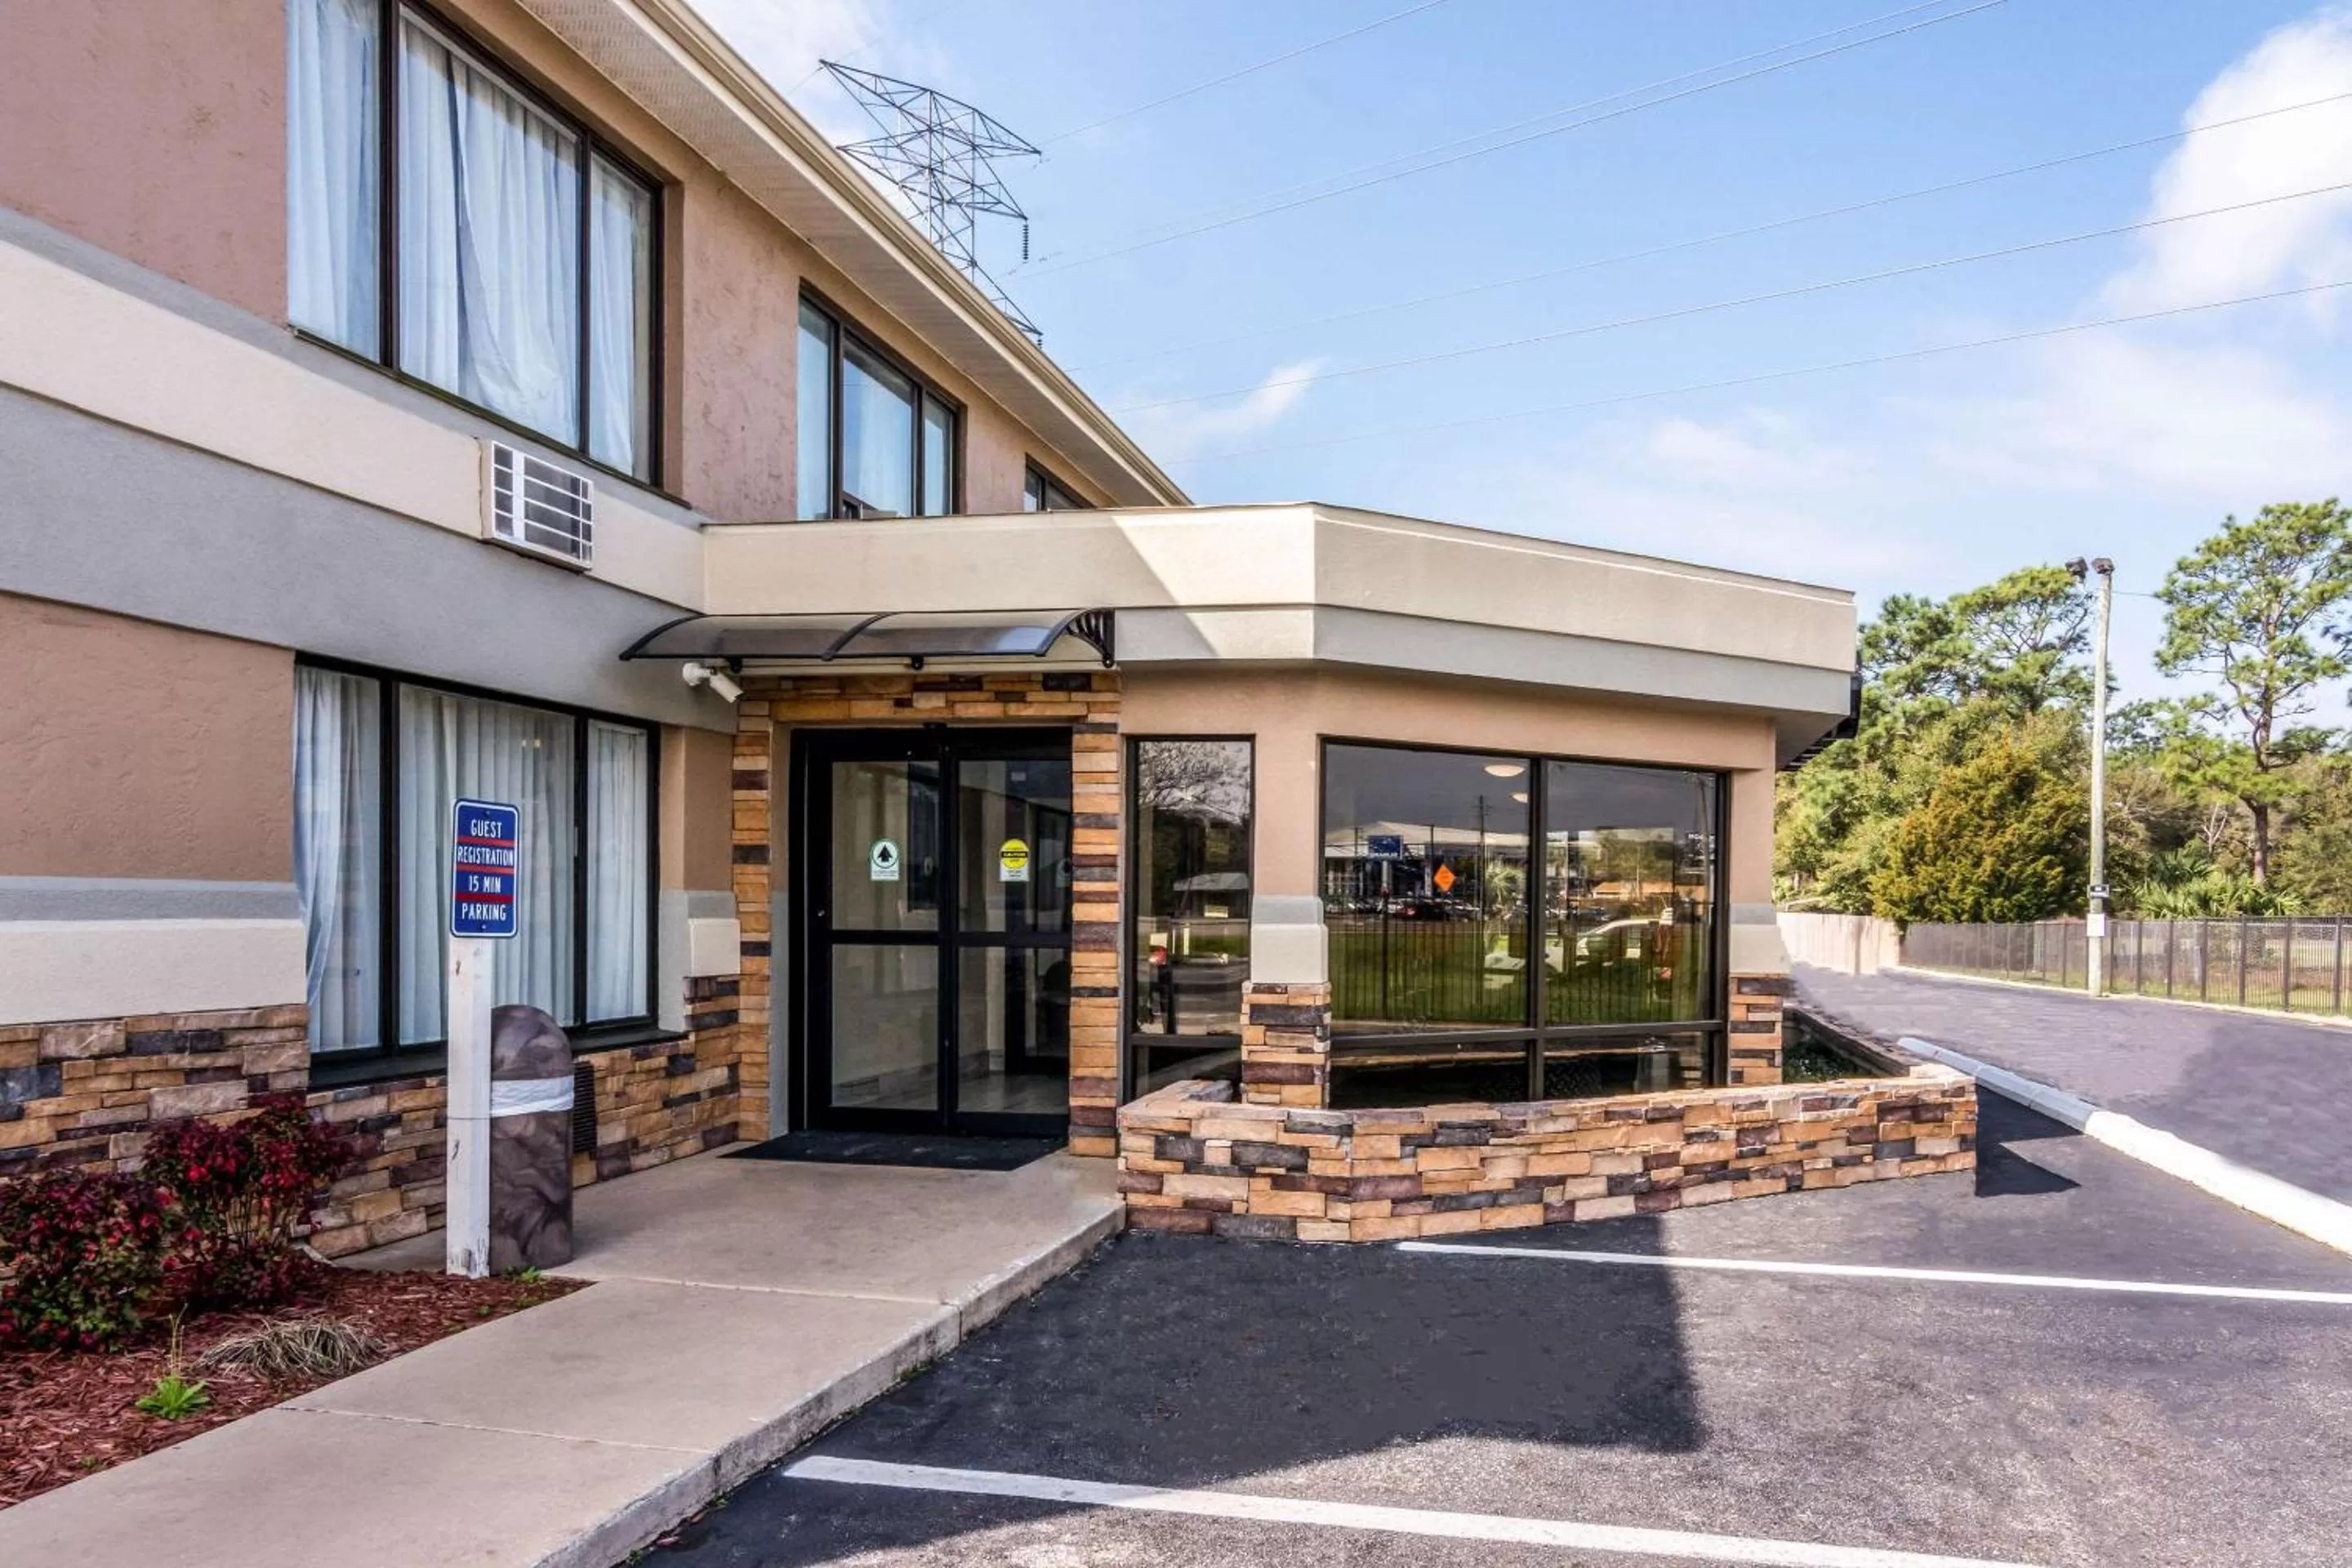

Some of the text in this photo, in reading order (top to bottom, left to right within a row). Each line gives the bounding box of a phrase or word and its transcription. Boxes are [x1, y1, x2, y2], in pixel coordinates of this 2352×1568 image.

[470, 819, 502, 838] GUEST
[457, 846, 514, 866] REGISTRATION
[469, 875, 501, 893] 15 MIN
[461, 902, 506, 921] PARKING
